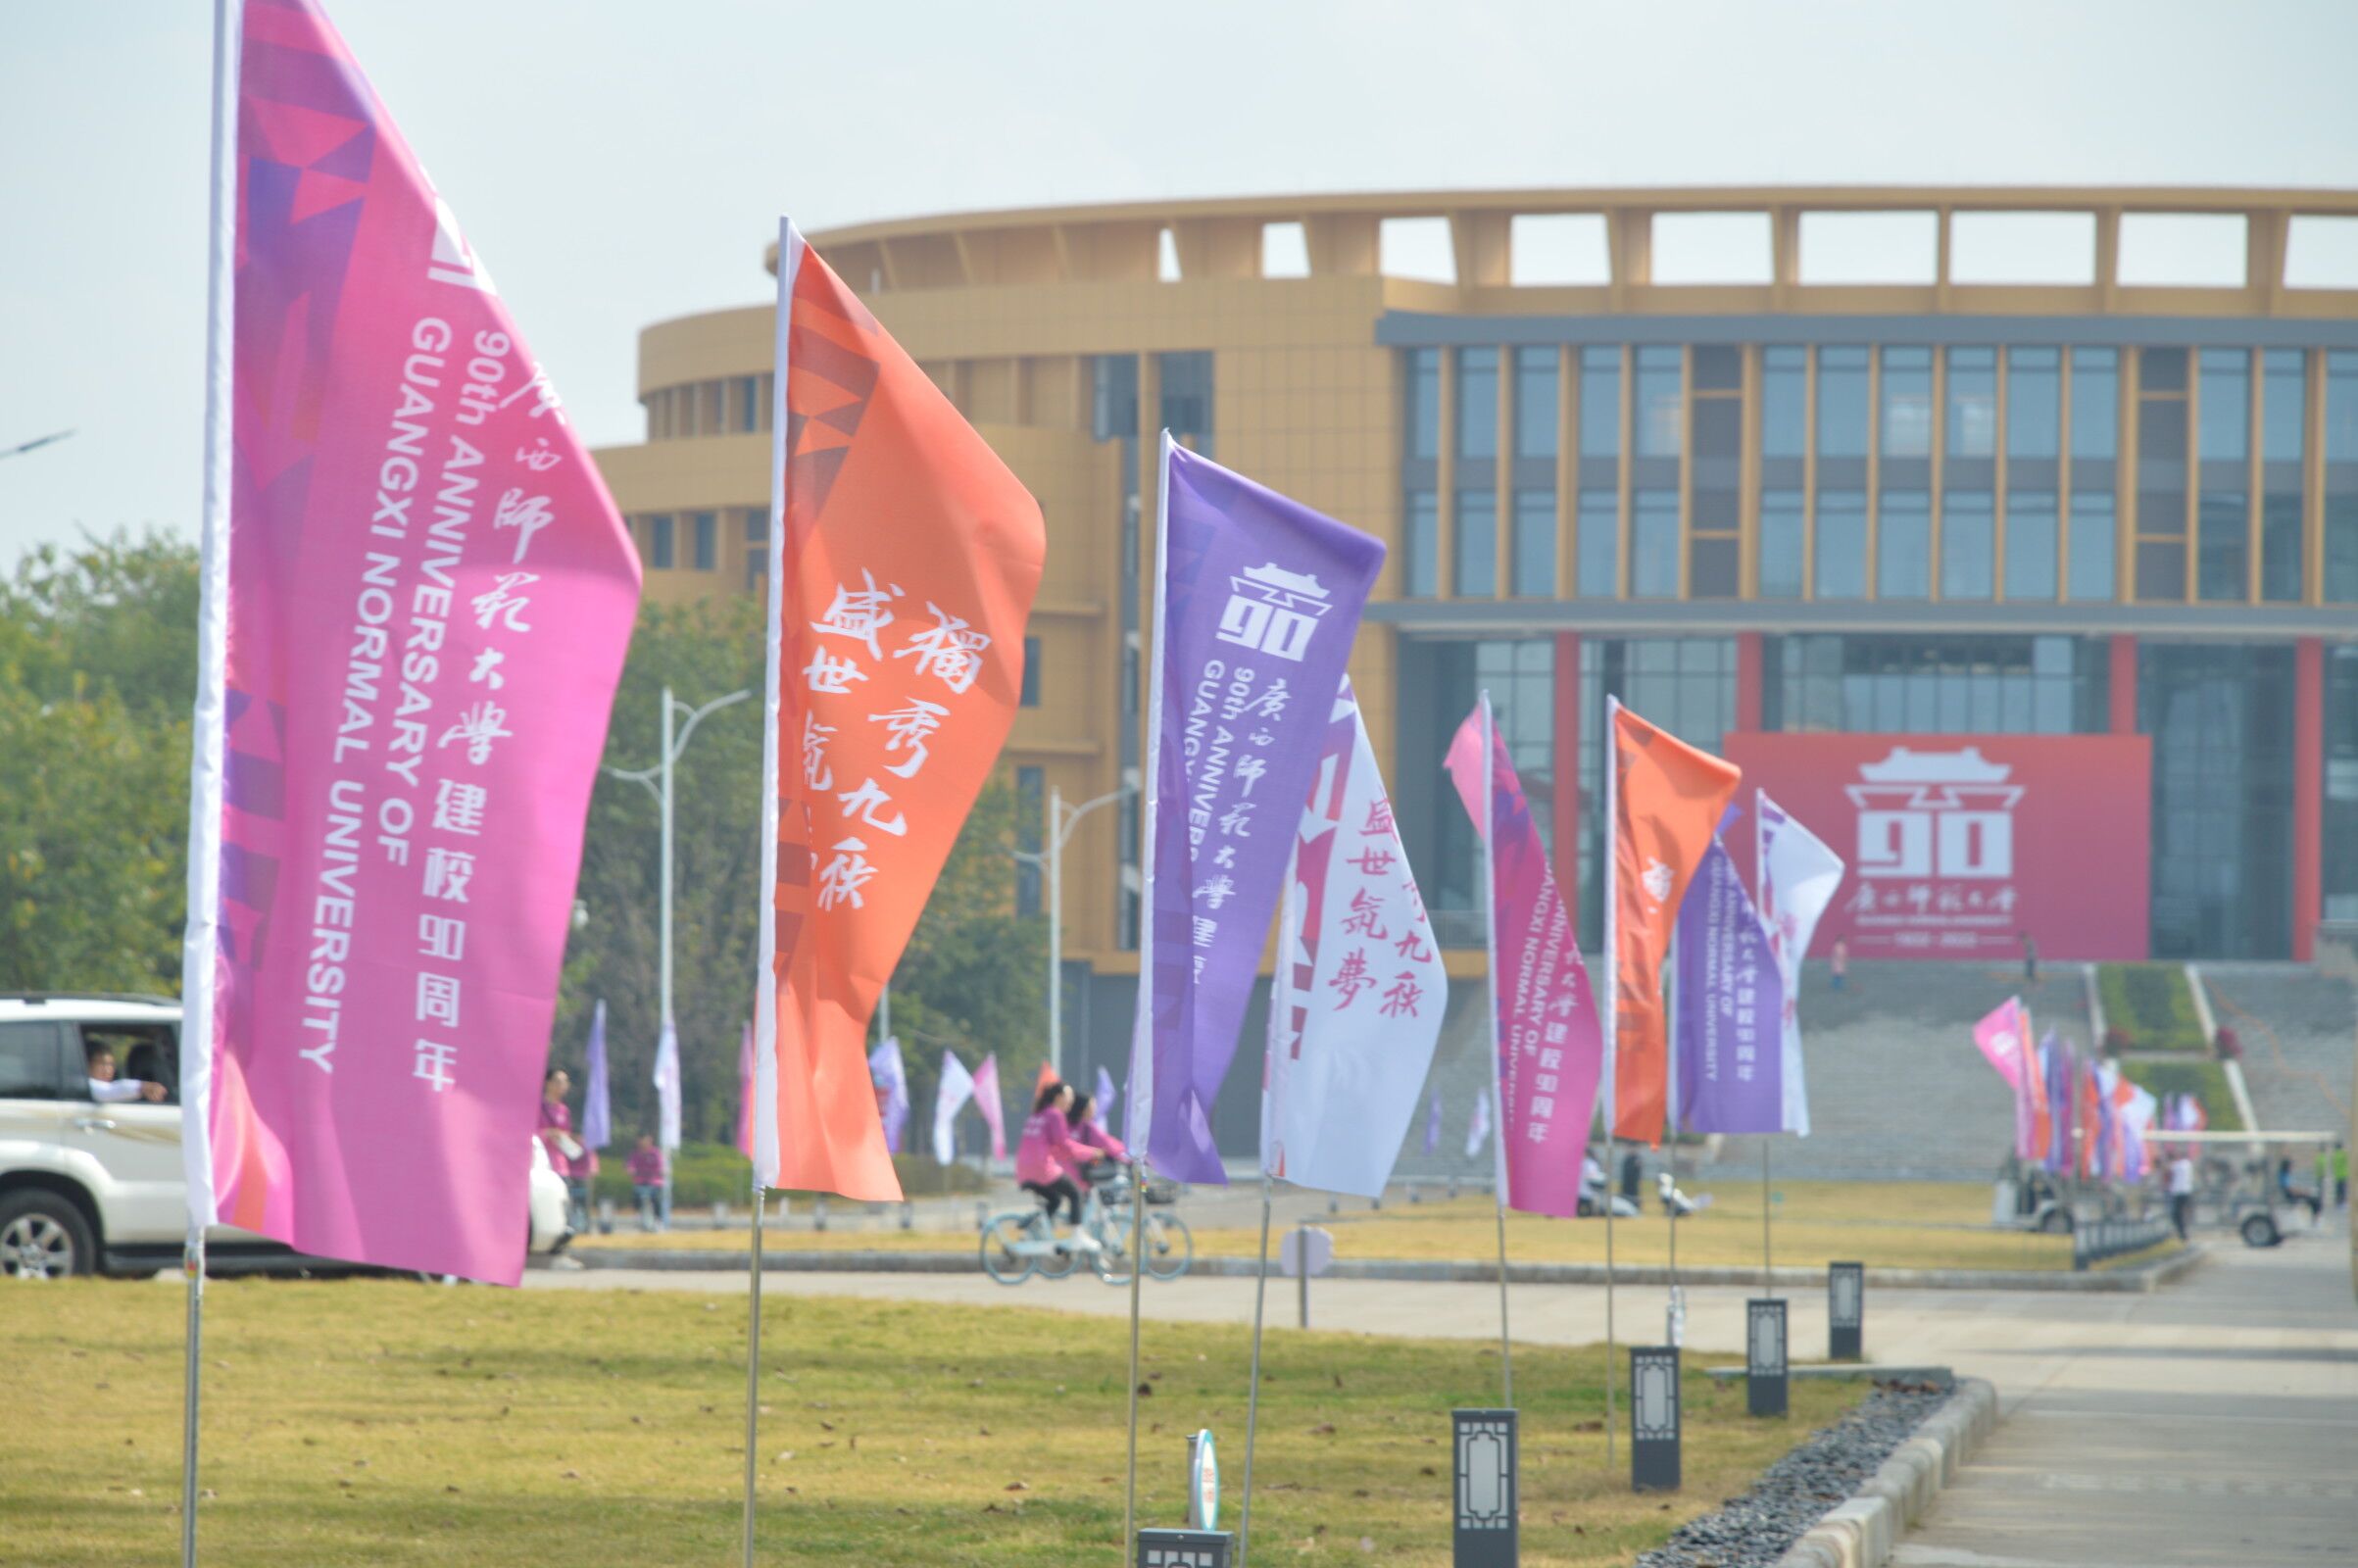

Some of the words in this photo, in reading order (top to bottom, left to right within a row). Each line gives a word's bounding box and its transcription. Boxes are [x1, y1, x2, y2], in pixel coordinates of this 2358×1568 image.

[456, 330, 512, 426] 90th
[369, 318, 453, 540] GUANGXI
[387, 434, 486, 787] ANNIVERSARY
[333, 551, 402, 764] NORMAL
[1220, 666, 1255, 720] 90th
[377, 798, 415, 866] OF
[299, 780, 366, 1074] UNIVERSITY
[1514, 937, 1541, 1017] NORMAL
[1524, 1029, 1540, 1056] OF
[1705, 993, 1718, 1082] UNIVERSITY
